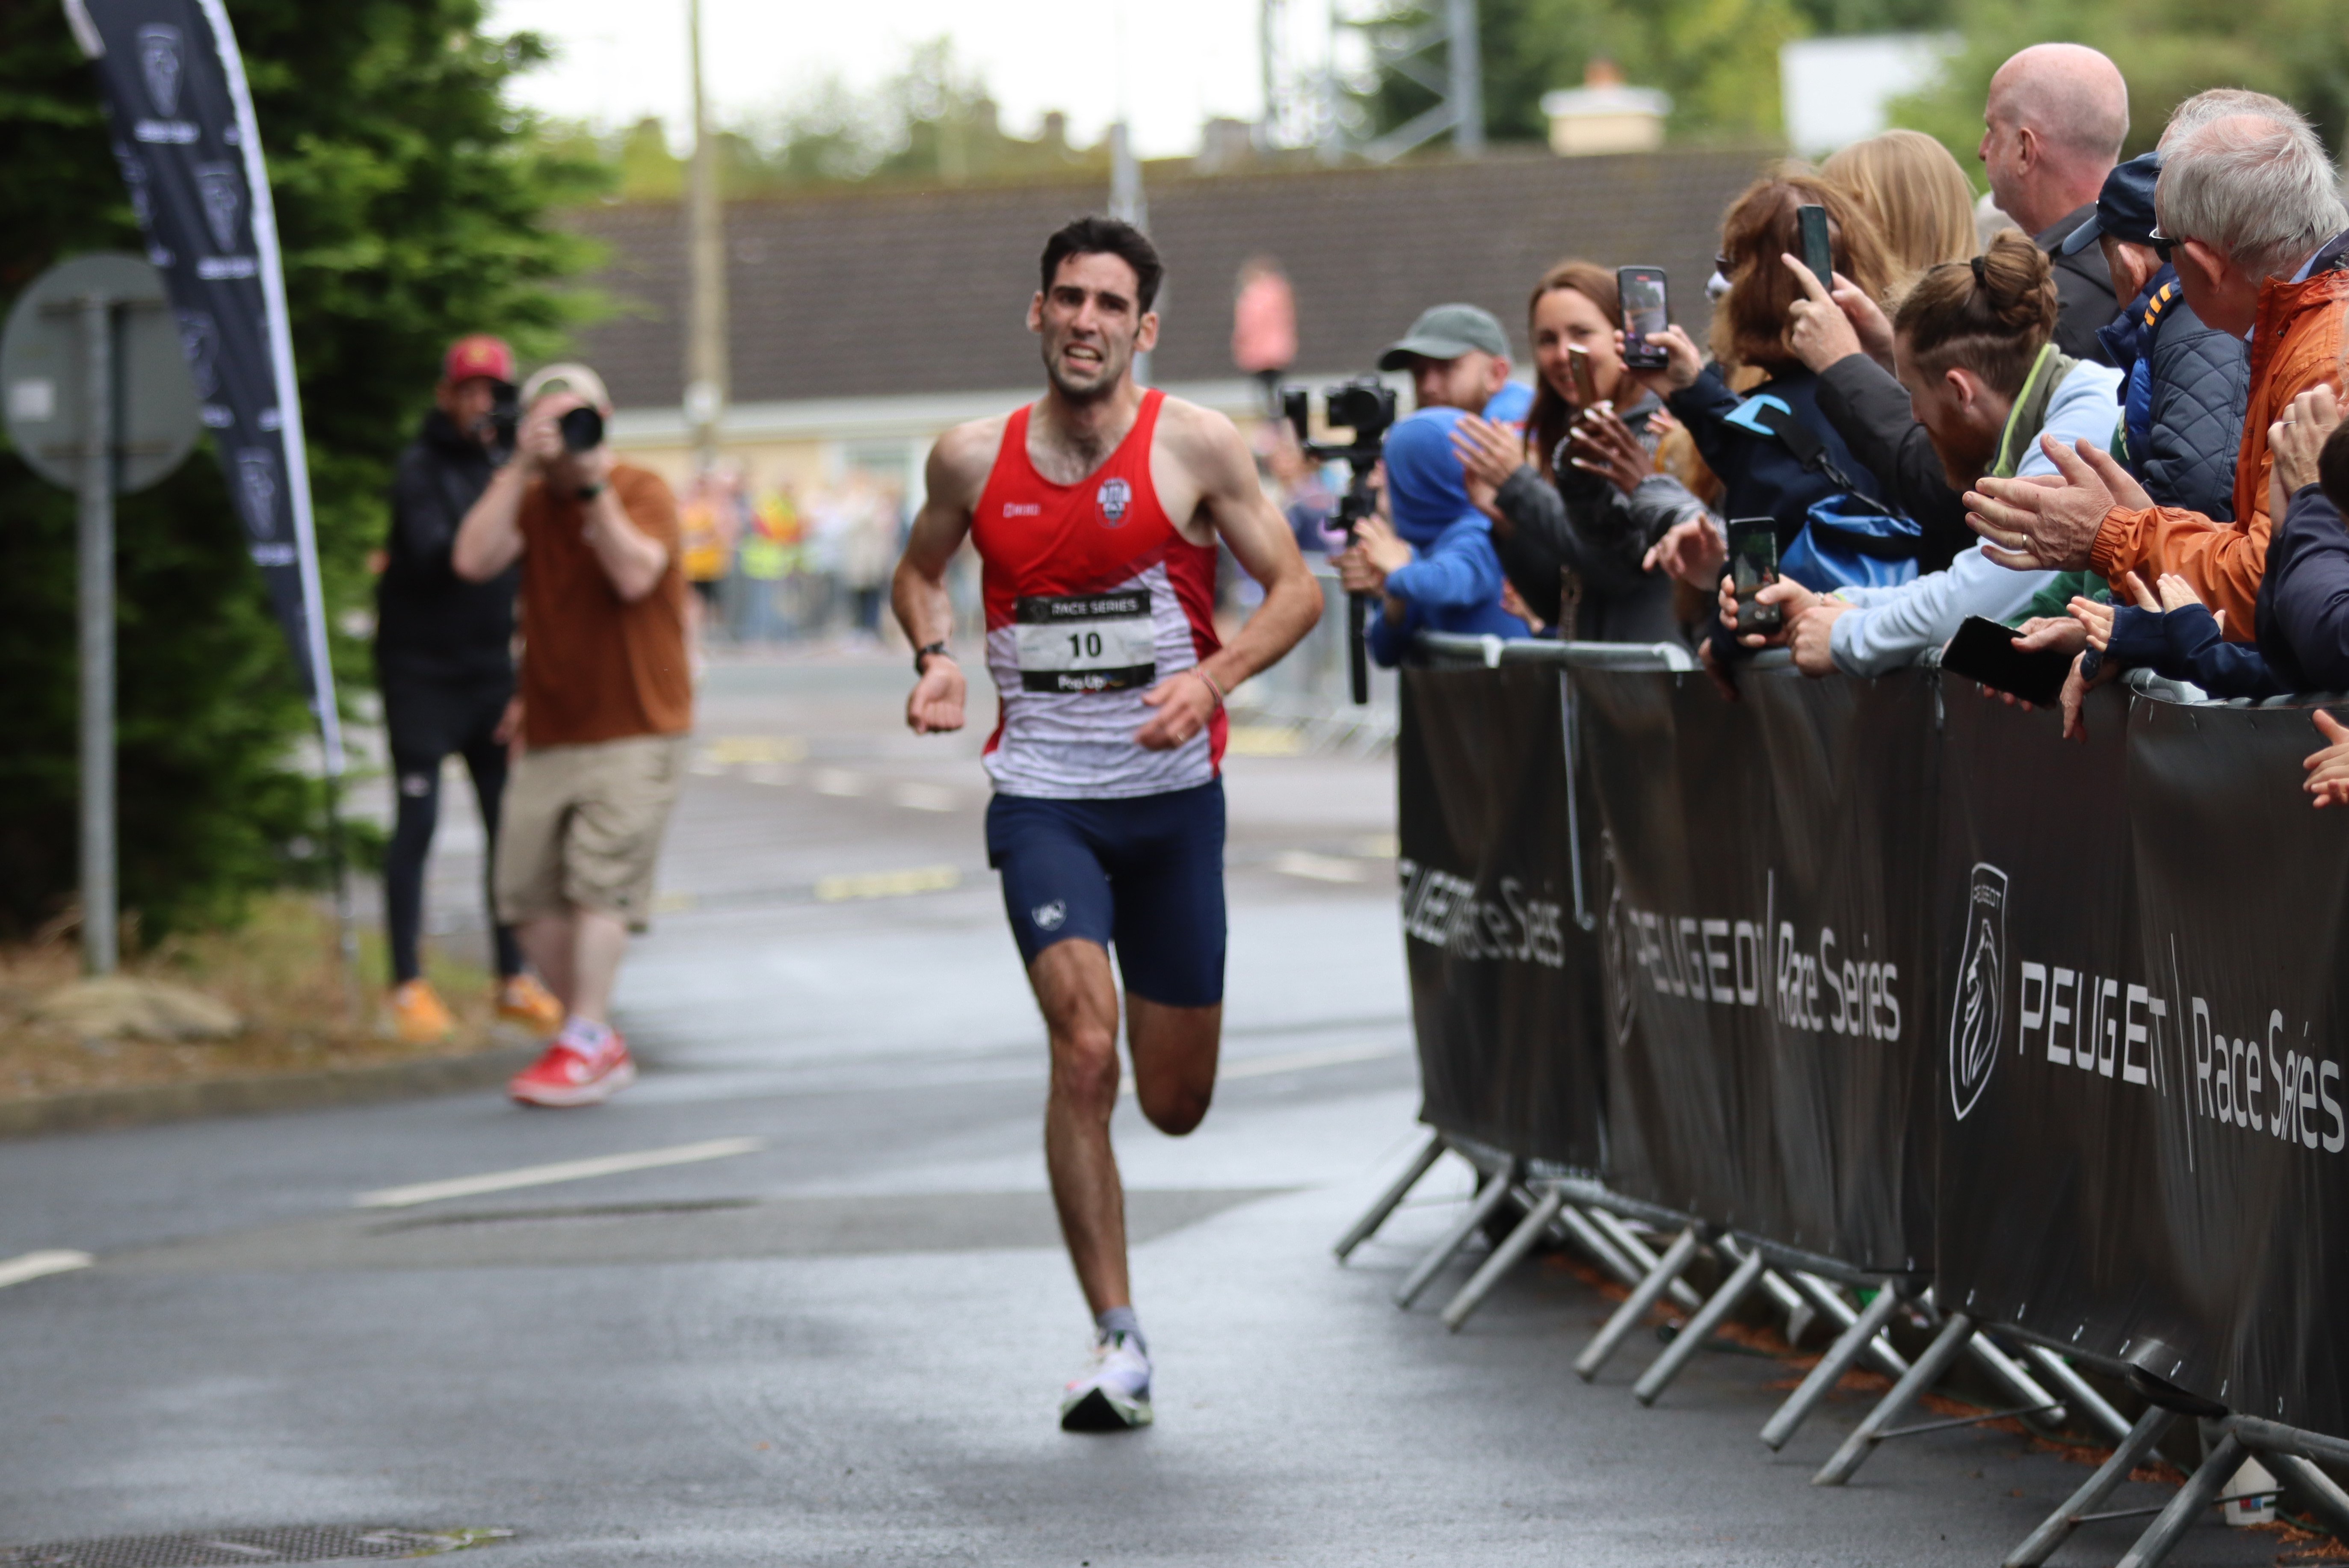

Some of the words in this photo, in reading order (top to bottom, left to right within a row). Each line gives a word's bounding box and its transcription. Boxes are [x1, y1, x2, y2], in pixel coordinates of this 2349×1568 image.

[1052, 602, 1088, 615] RACE
[1090, 598, 1139, 614] SERIES
[1068, 632, 1102, 658] 10
[1777, 920, 1823, 1032] Race
[1820, 926, 1902, 1042] Series
[2019, 961, 2166, 1097] PEUGET
[2192, 996, 2263, 1132] Race
